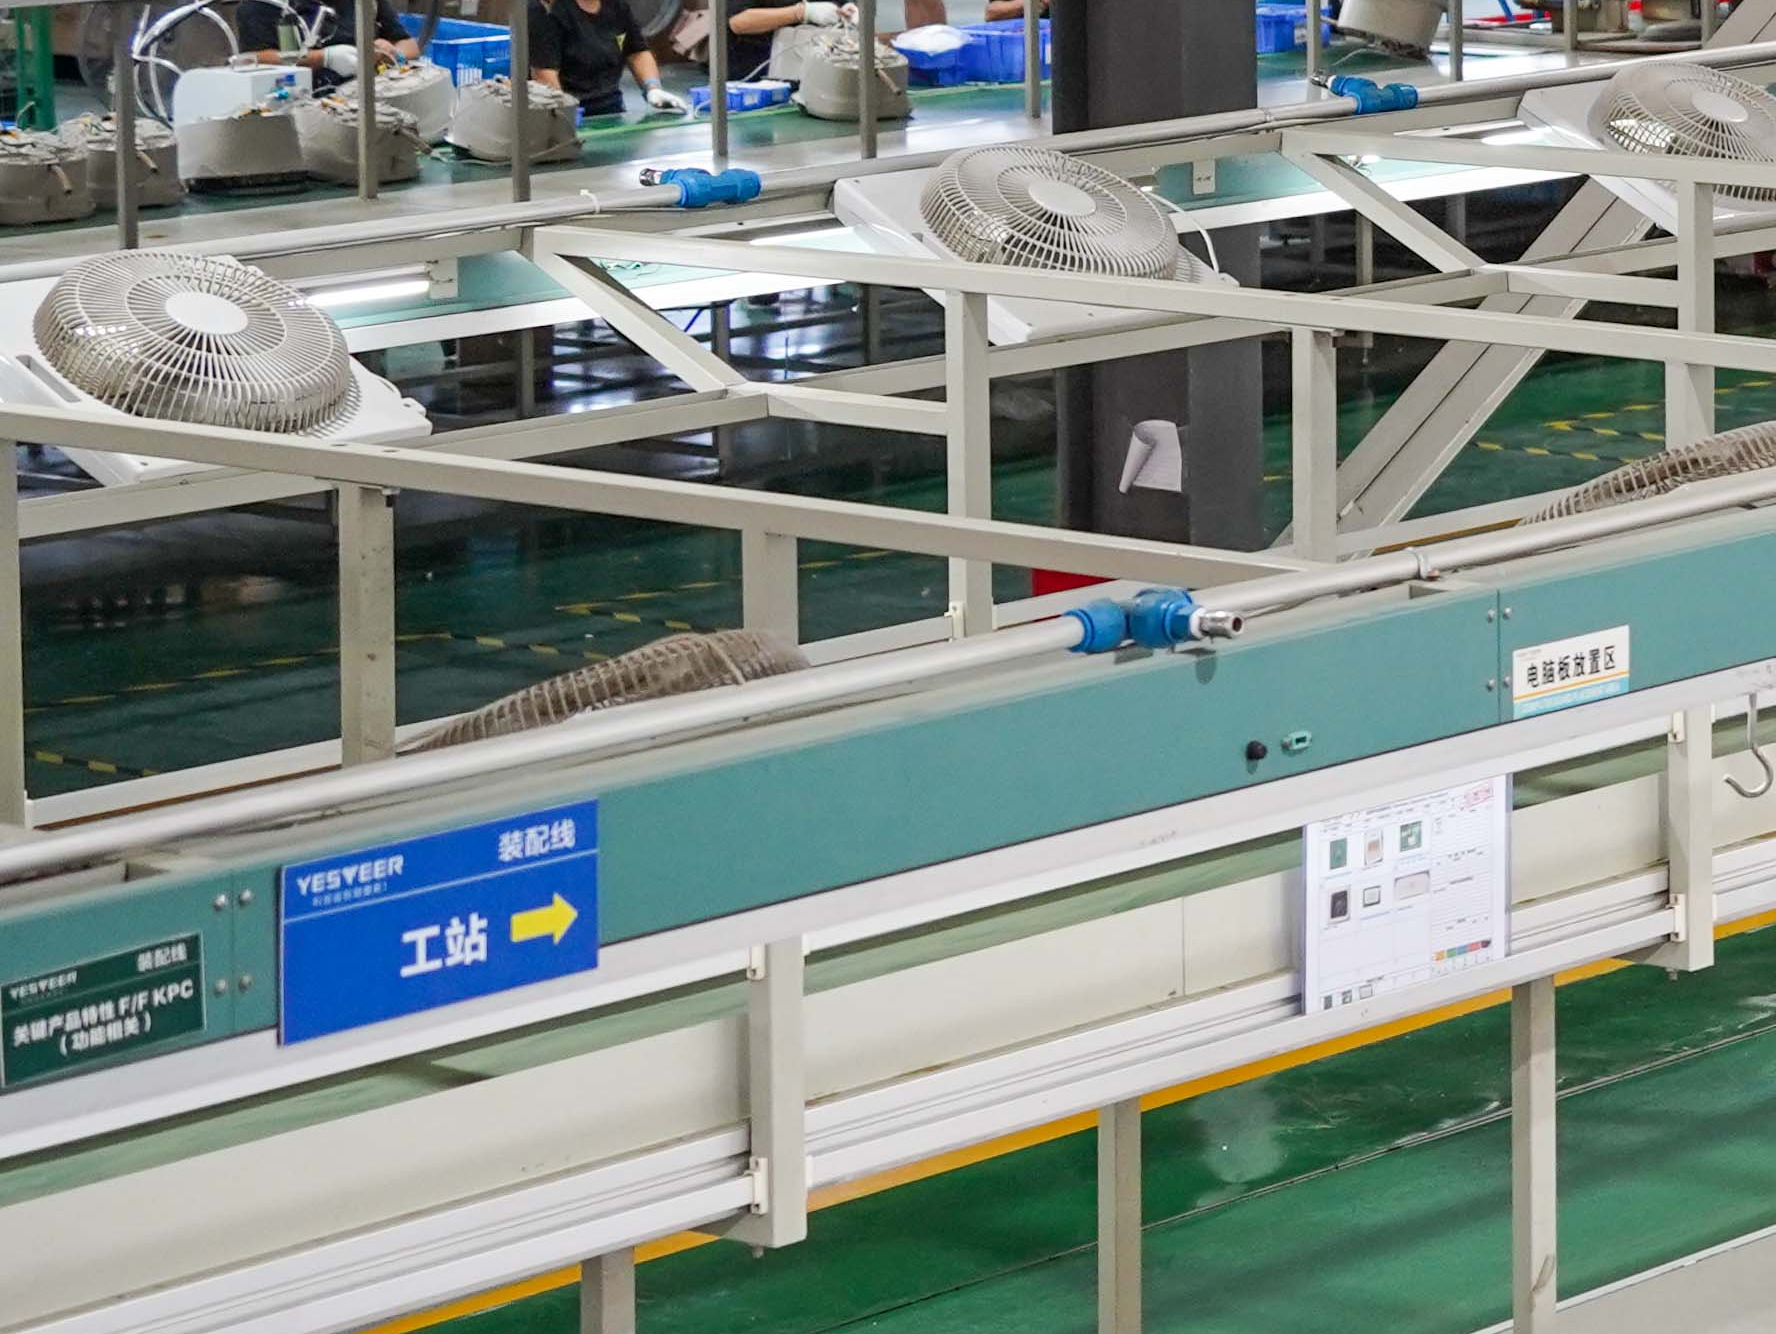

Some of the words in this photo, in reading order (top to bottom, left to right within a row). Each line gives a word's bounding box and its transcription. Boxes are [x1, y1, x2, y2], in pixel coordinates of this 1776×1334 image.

[1526, 644, 1616, 689] 电脑板放置区
[497, 818, 577, 863] 装配线
[296, 854, 404, 897] YESVEER
[399, 910, 490, 979] 工站
[9, 971, 78, 1000] YESVEER
[13, 999, 115, 1048] 关键产品特性
[118, 992, 149, 1016] F/F
[153, 979, 194, 1008] KPC
